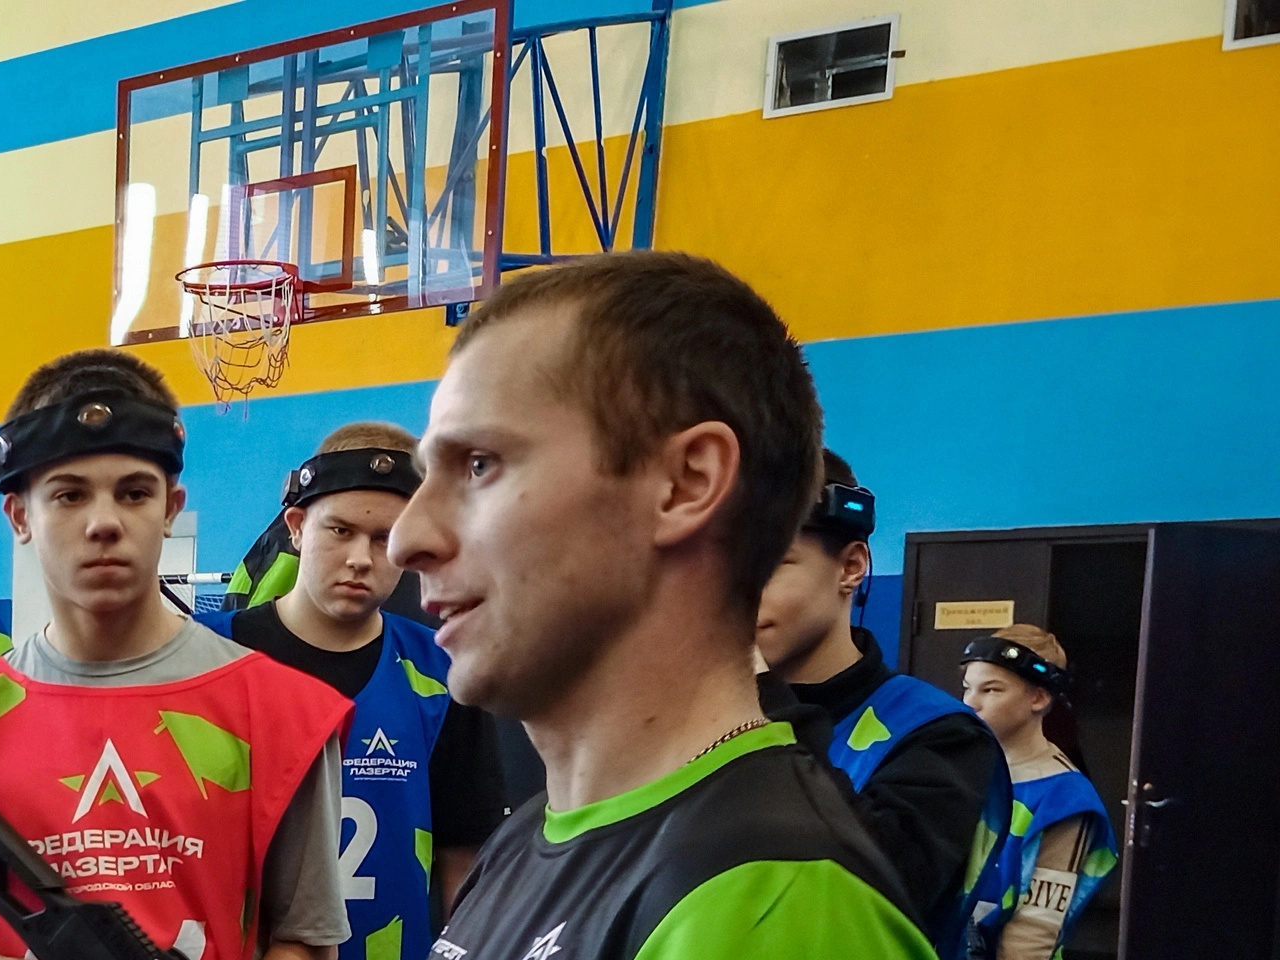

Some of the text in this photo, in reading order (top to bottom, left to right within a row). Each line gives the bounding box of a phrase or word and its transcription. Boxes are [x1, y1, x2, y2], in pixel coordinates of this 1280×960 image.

[342, 758, 418, 769] ФЕДЕРАЦИЯ
[349, 767, 412, 777] ЛАЗЕРТАГ
[337, 796, 378, 900] 2
